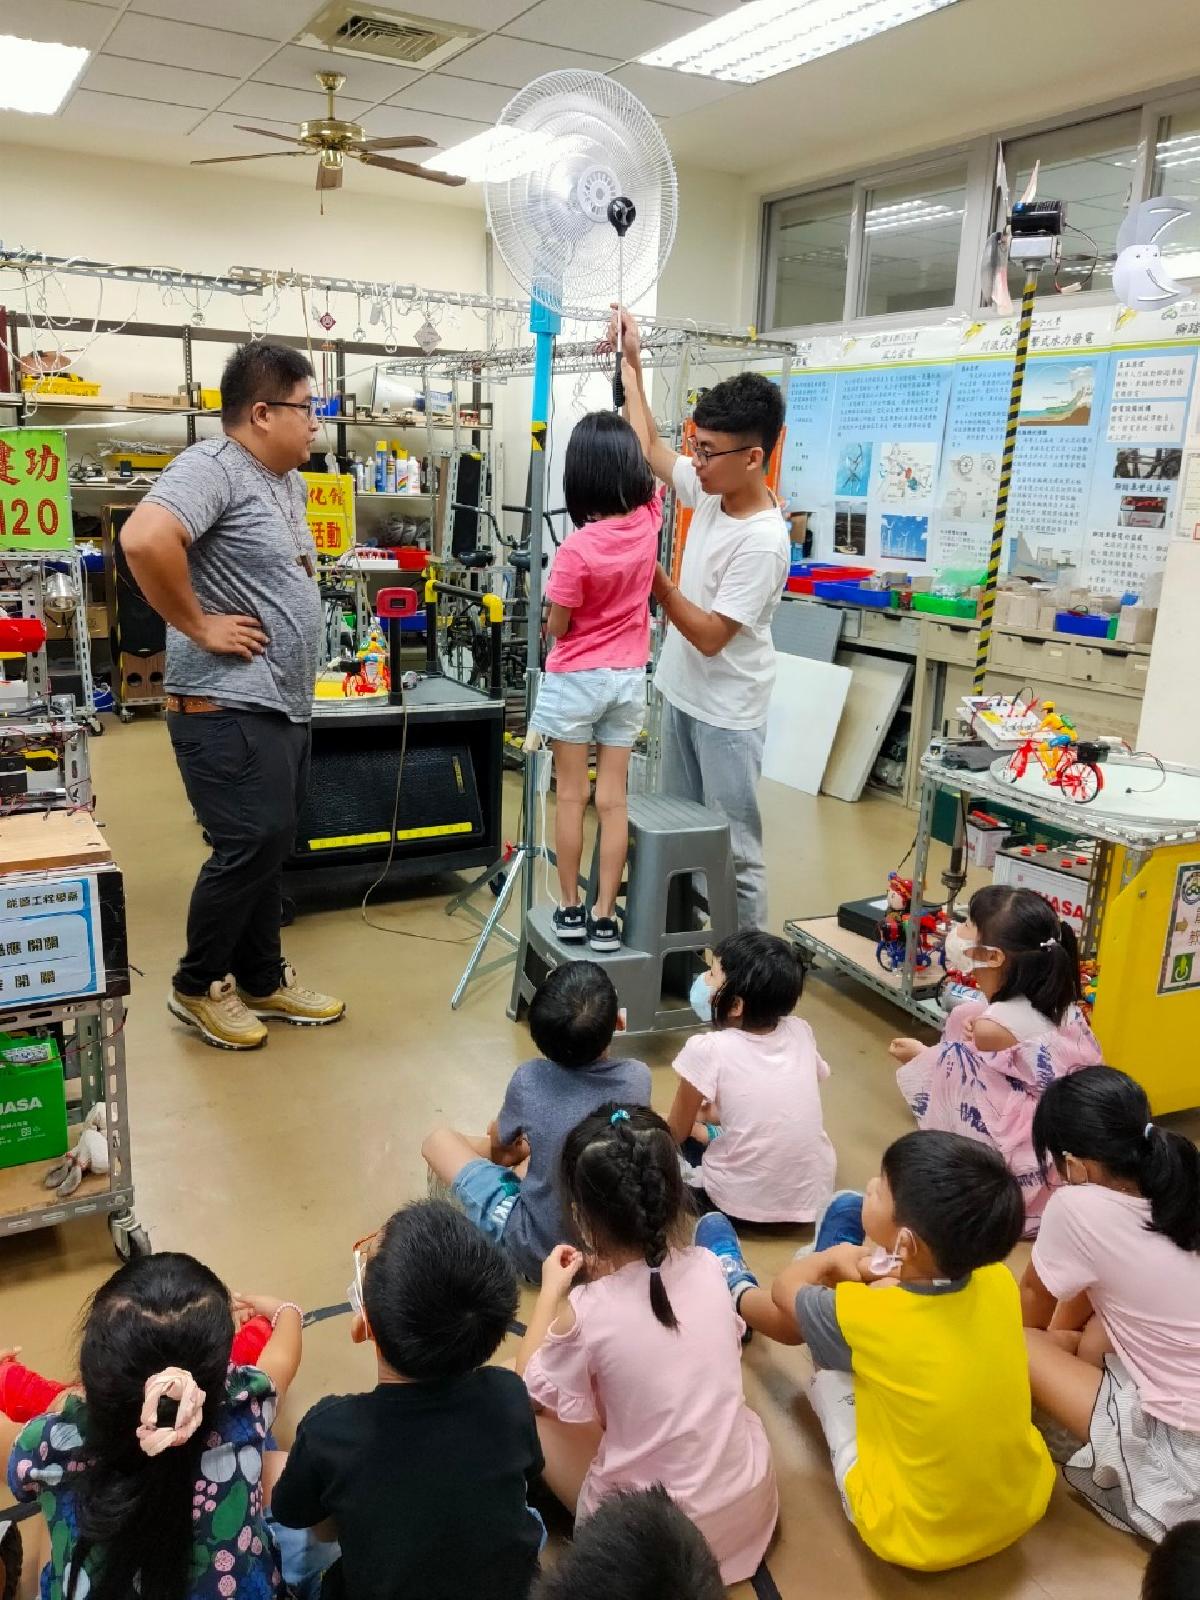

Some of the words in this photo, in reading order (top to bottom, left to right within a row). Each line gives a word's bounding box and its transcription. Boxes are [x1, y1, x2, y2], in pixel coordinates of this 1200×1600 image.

[308, 521, 341, 548] 活動
[6, 891, 78, 909] 能源工程學系
[27, 935, 59, 953] 開關
